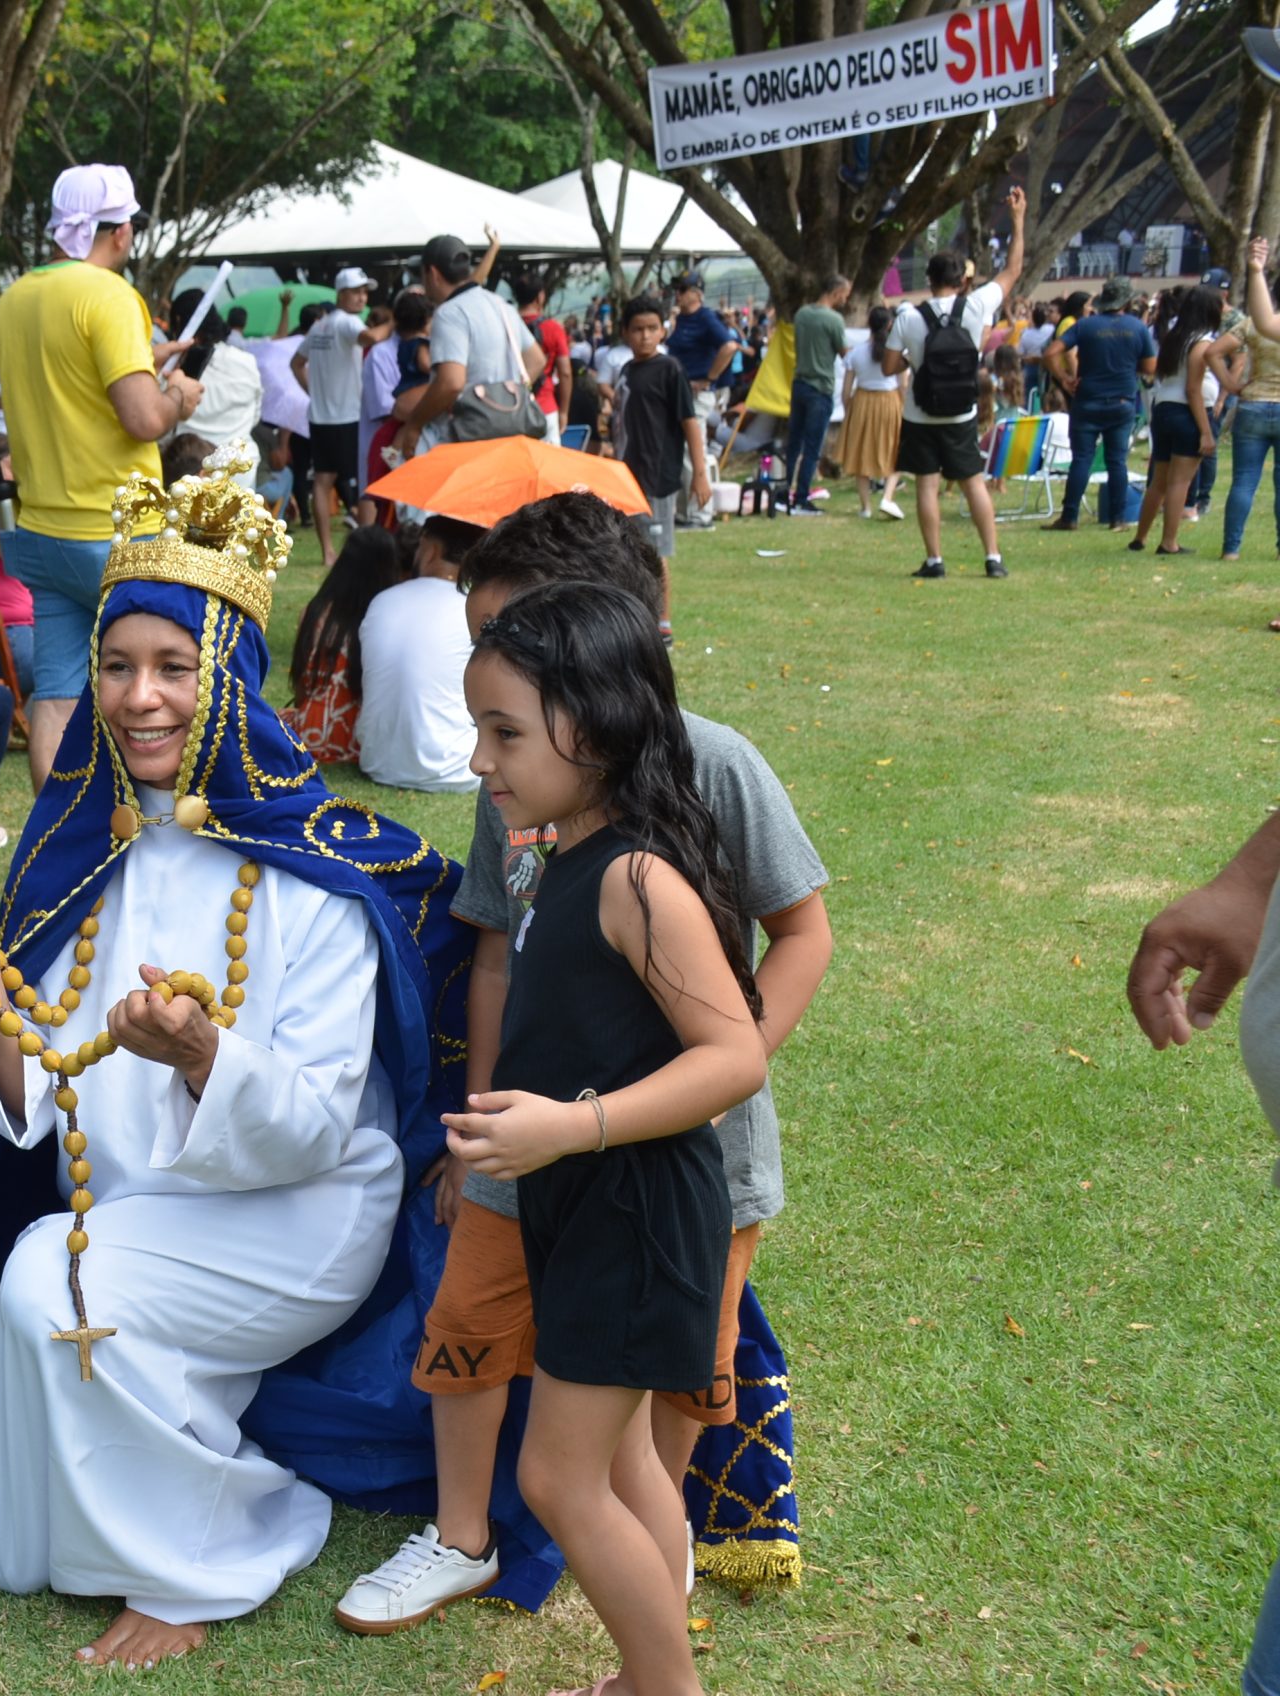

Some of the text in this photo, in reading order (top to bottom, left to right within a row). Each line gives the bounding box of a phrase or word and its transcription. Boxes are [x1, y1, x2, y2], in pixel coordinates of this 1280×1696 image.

[665, 0, 1043, 124] MAMÃE, OBRIGADO PELO SEU SIM
[664, 148, 677, 162] O
[682, 133, 756, 160] EMBRIÃO
[761, 130, 780, 147] DE
[785, 116, 846, 141] ONTEM
[852, 109, 861, 129] É
[866, 111, 881, 126] O
[886, 103, 918, 122] SEU
[924, 91, 979, 116] FILHO
